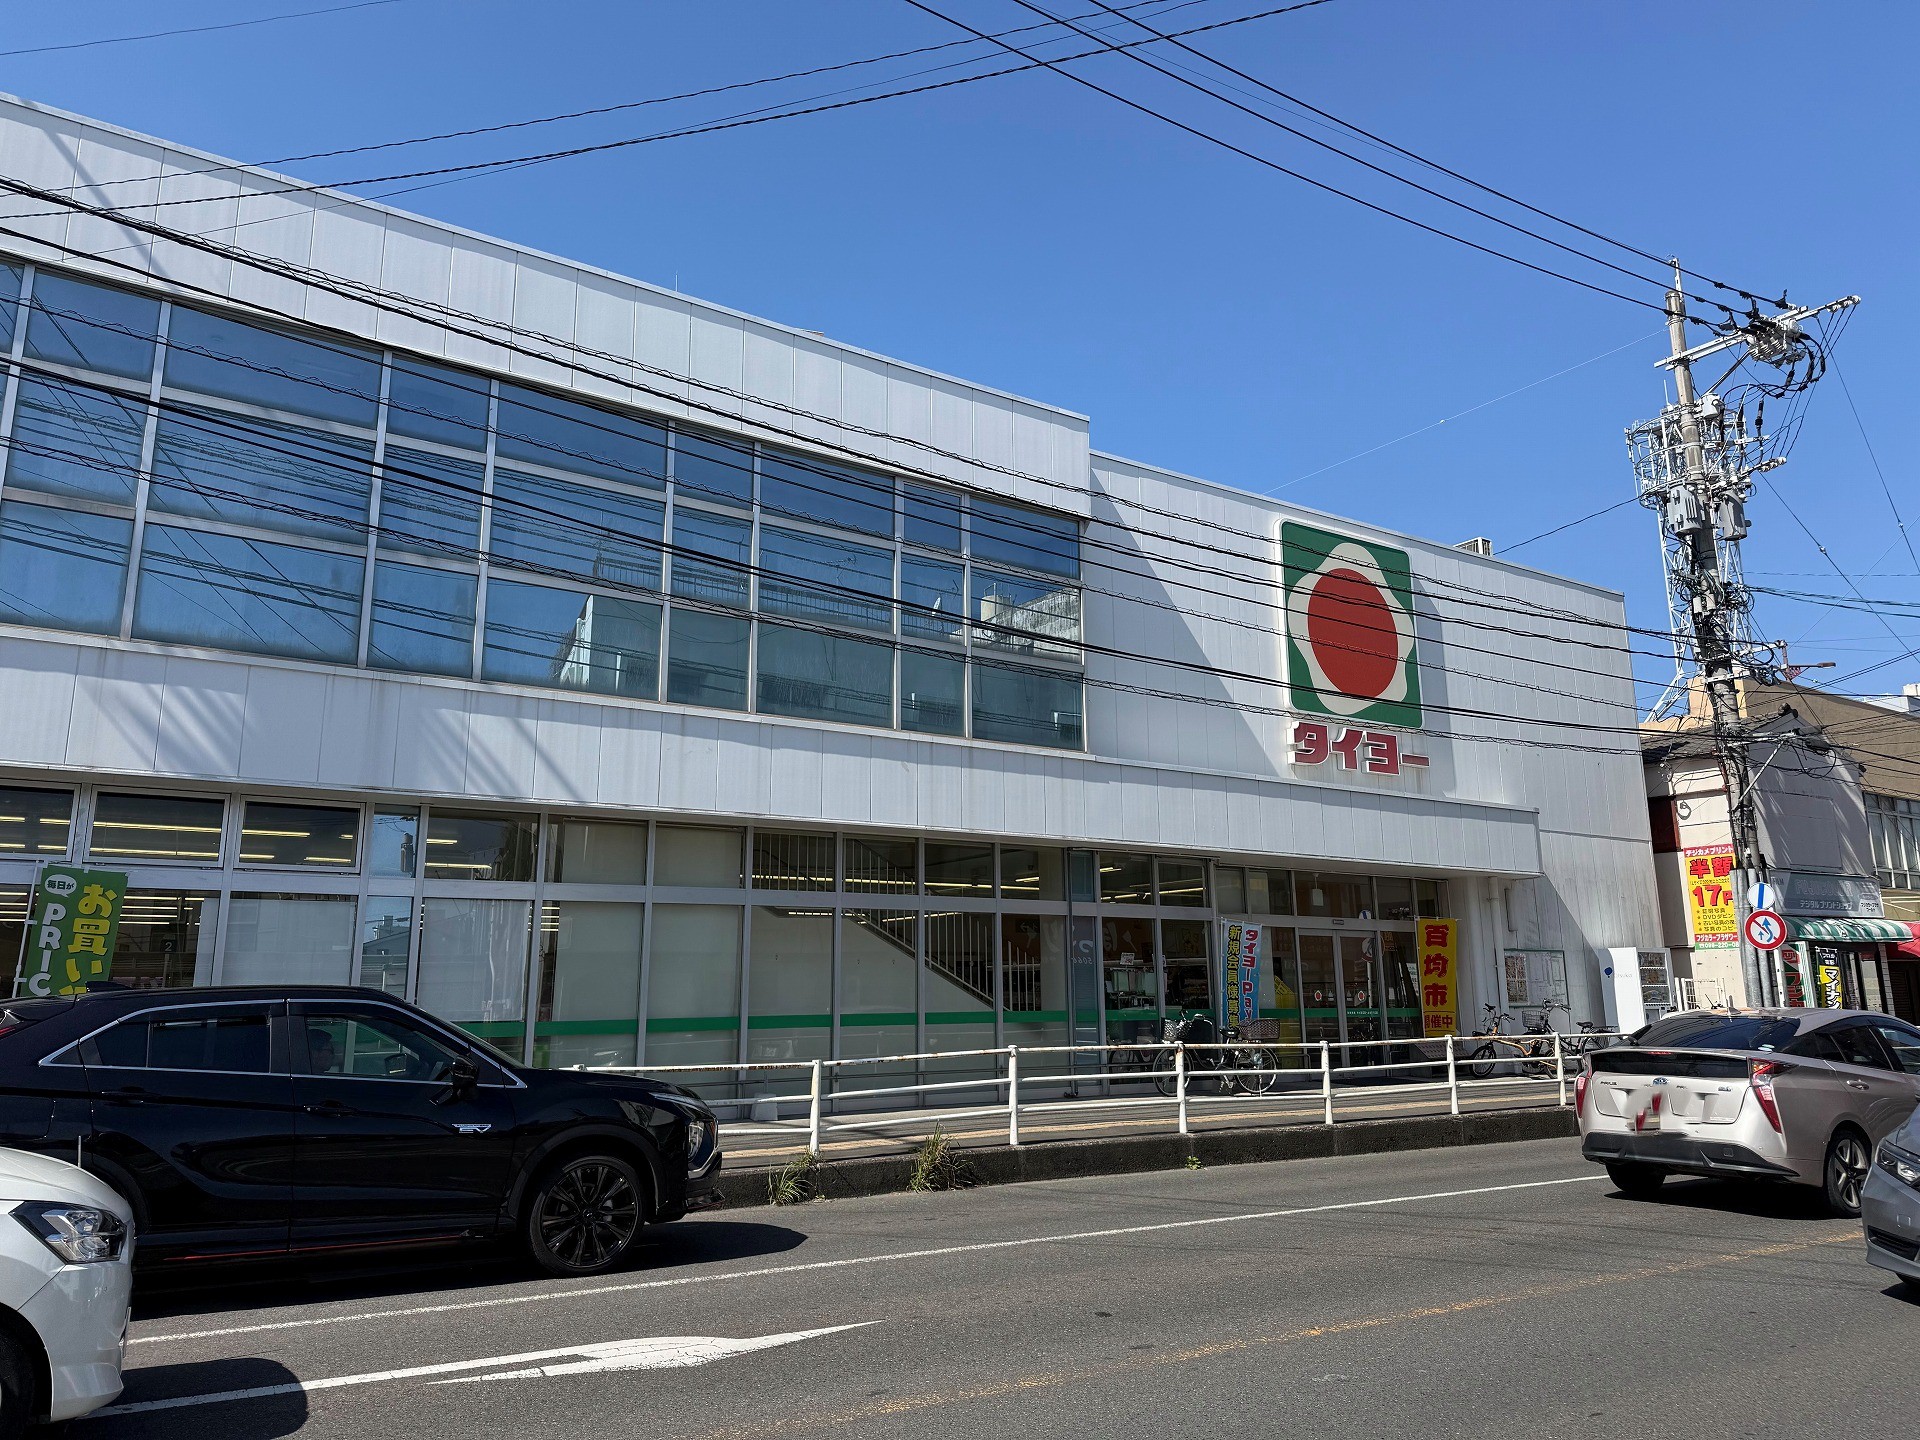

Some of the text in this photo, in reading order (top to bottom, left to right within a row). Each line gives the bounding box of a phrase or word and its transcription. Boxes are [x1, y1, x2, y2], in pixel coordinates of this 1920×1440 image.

[1288, 721, 1430, 775] タイヨー
[1686, 846, 1733, 856] デジカメプリント
[1690, 856, 1733, 879] 半額
[47, 880, 75, 890] 毎日が
[1424, 923, 1449, 1007] 百均市
